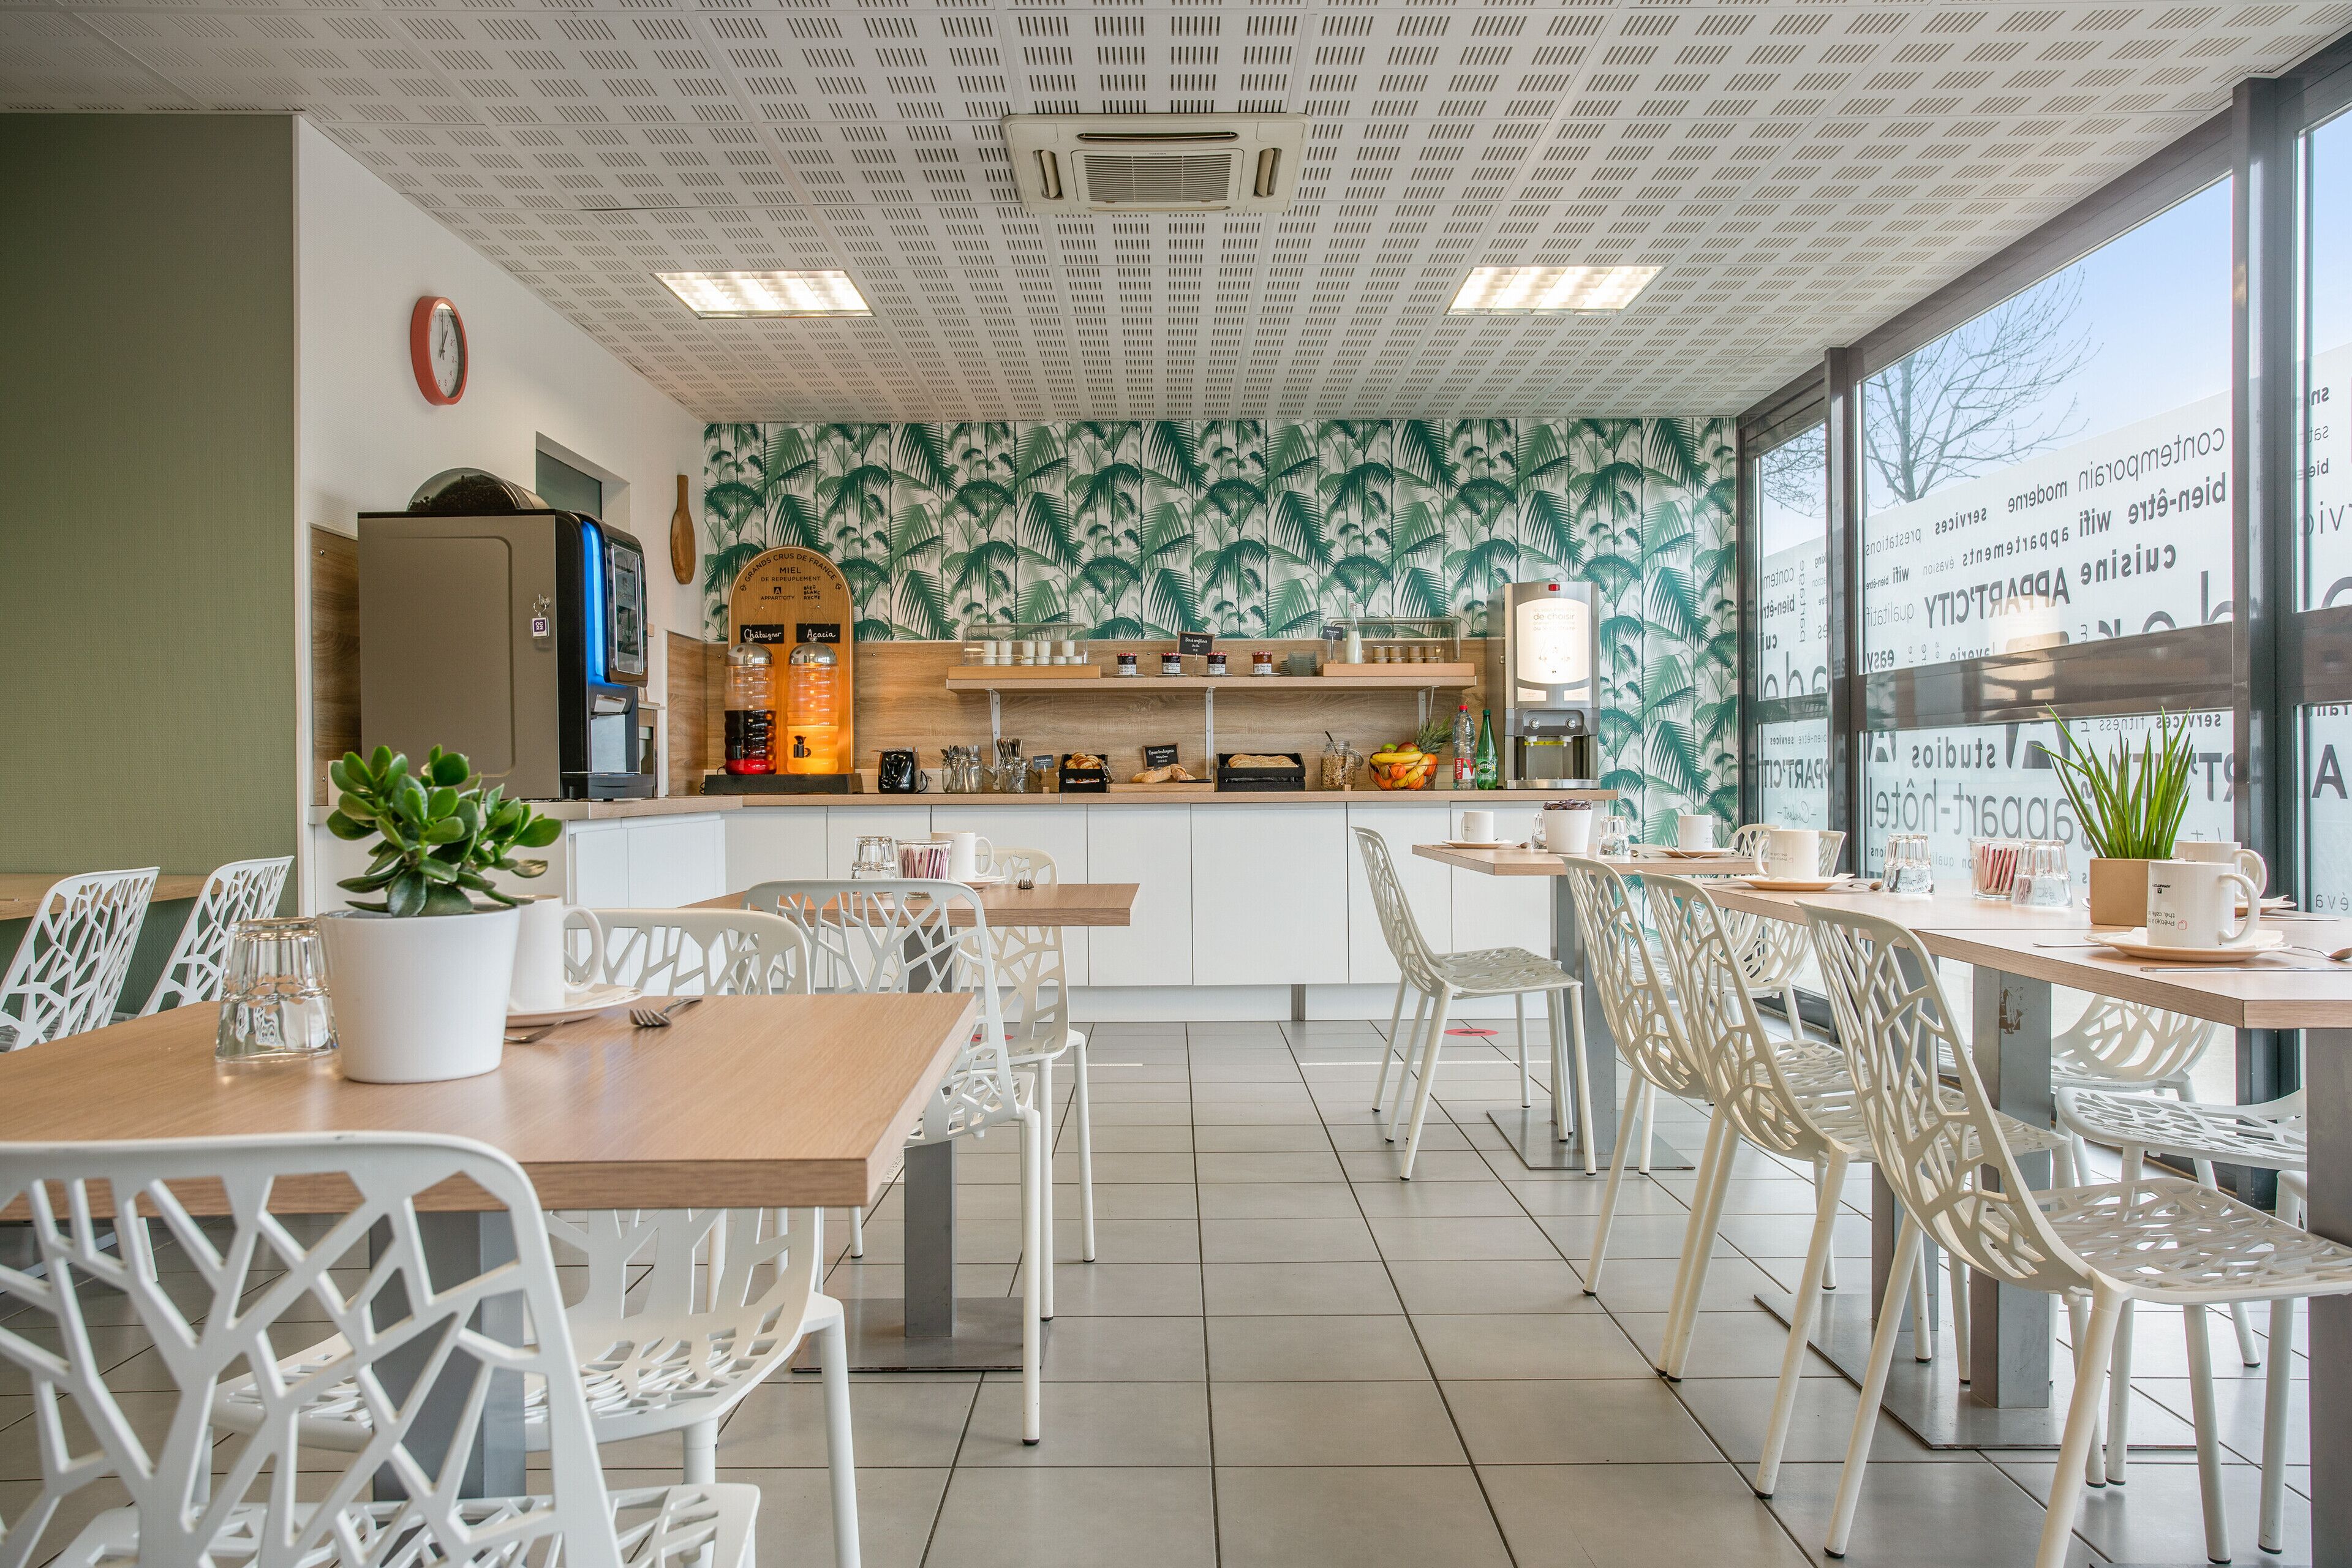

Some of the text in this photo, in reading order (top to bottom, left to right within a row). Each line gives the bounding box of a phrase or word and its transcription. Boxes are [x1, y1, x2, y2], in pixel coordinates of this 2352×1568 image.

[745, 557, 772, 582] GRANDS
[809, 557, 837, 581] FRANCE
[807, 628, 836, 638] Acacia
